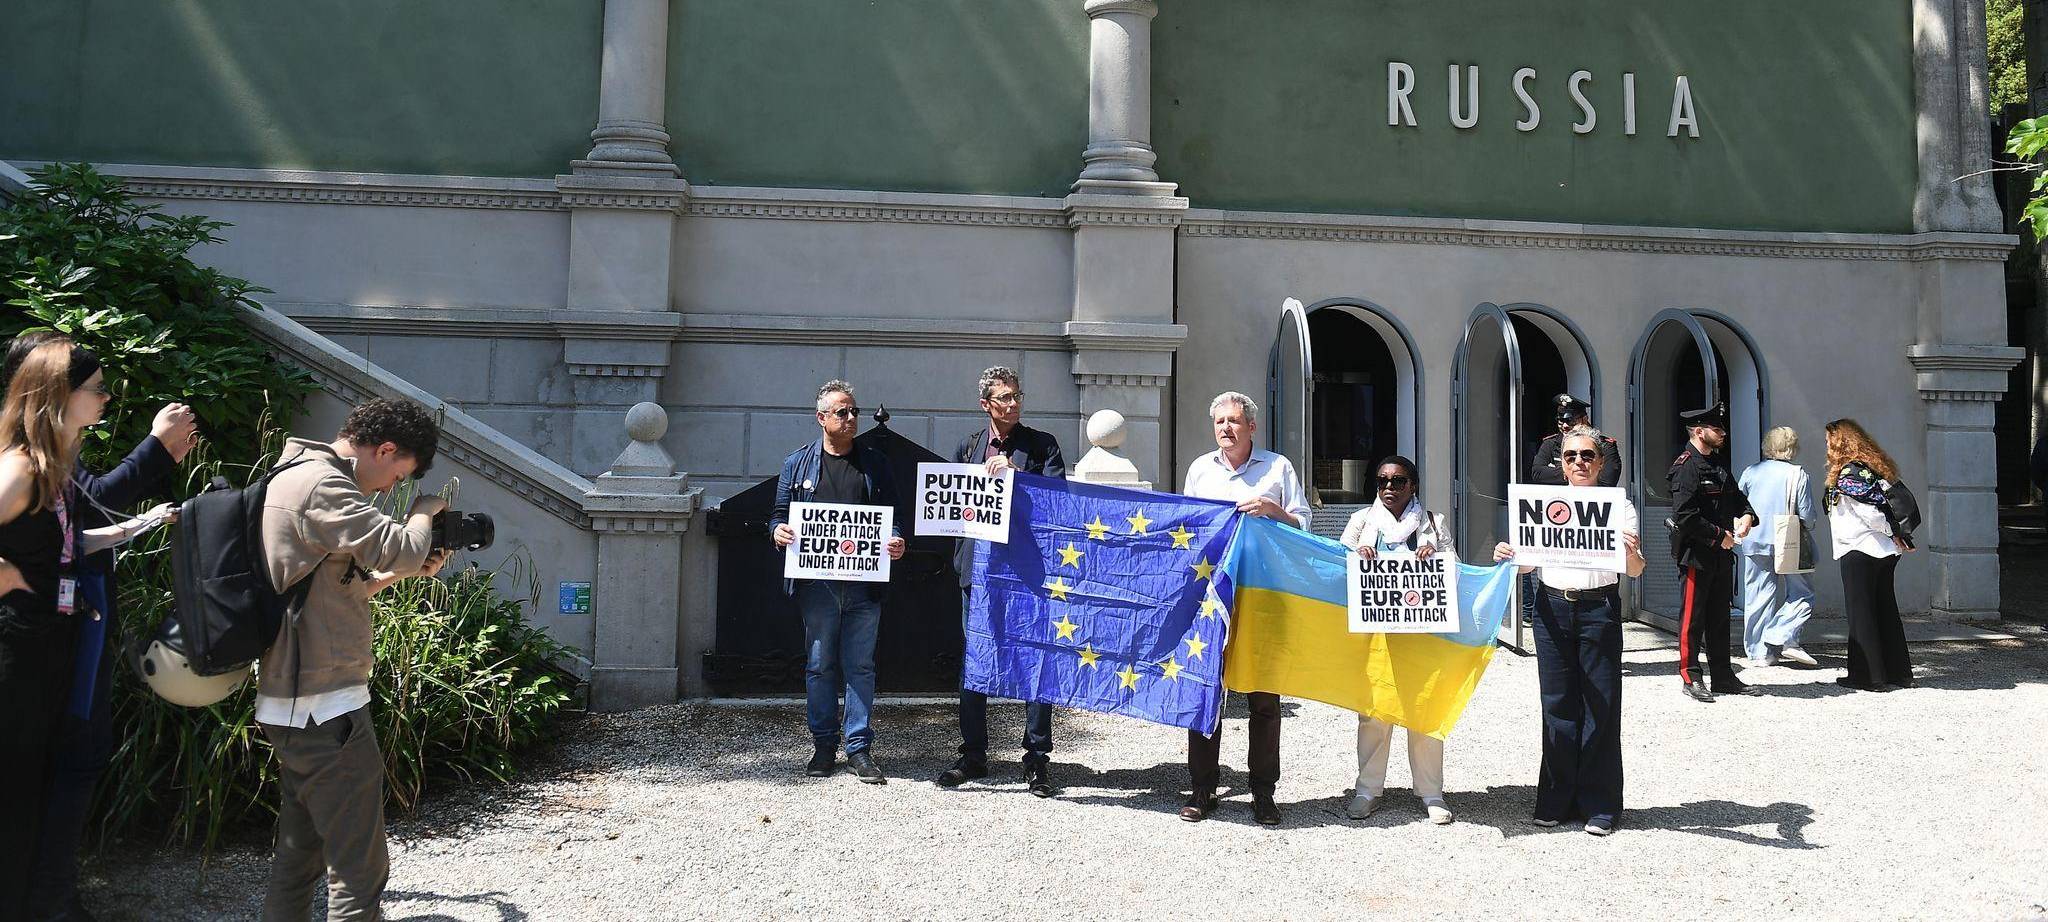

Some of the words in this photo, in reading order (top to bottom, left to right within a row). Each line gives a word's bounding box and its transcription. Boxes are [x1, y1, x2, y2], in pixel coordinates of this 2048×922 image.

[1388, 62, 1700, 137] RUSSIA
[925, 474, 1004, 493] PUTIN'S
[925, 491, 1003, 510] CULTURE
[802, 509, 882, 525] UKRAINE
[924, 506, 934, 520] IS
[938, 506, 945, 520] A
[801, 523, 836, 537] UNDER
[840, 525, 881, 539] ATTACK
[1519, 526, 1535, 546] IN
[1542, 527, 1616, 551] UKRAINE
[799, 554, 834, 569] UNDER
[838, 557, 879, 571] ATTACK
[1359, 559, 1444, 573] UKRAINE
[1360, 575, 1398, 589] UNDER
[1402, 574, 1445, 589] ATTACK
[1362, 608, 1400, 622] UNDER
[1404, 608, 1447, 622] ATTACK
